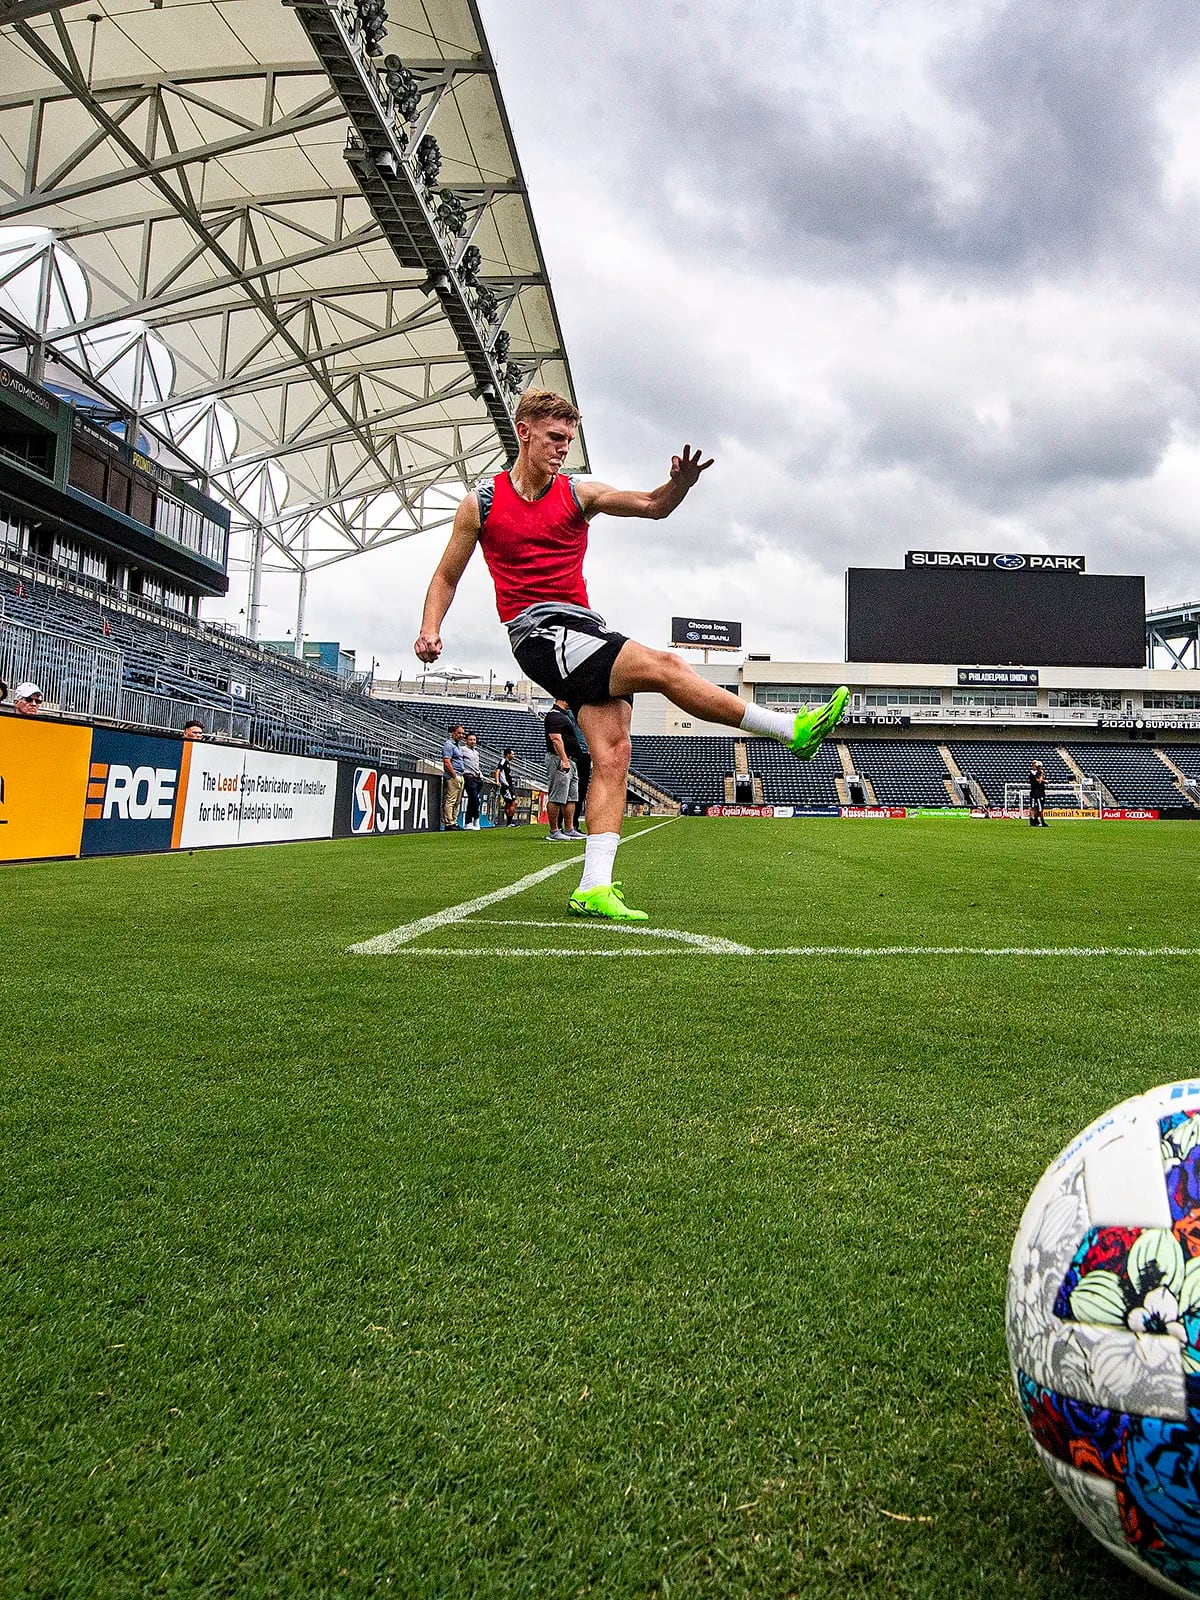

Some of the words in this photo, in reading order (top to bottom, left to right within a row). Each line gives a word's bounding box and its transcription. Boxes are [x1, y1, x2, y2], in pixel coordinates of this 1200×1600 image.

[912, 553, 989, 567] SUBARU
[1030, 556, 1081, 570] PARK
[688, 622, 713, 631] Choose
[713, 623, 729, 632] love.
[701, 634, 730, 642] SUBARU
[968, 672, 1009, 682] PHILADELPHIA
[1009, 673, 1028, 682] UNION
[852, 716, 867, 724] LE
[869, 716, 903, 725] TOUX
[1101, 719, 1134, 728] 2020
[202, 771, 216, 791] The
[217, 773, 239, 792] Lead
[240, 774, 255, 796] Sign
[256, 775, 292, 794] Fabricator
[293, 779, 303, 794] and
[303, 780, 327, 795] Installer
[377, 773, 429, 833] SEPTA
[199, 802, 211, 821] for
[212, 802, 225, 821] the
[227, 802, 272, 824] Philadelphia
[273, 803, 293, 820] Union
[740, 806, 761, 817] Morgan
[841, 807, 890, 818] Musselman's
